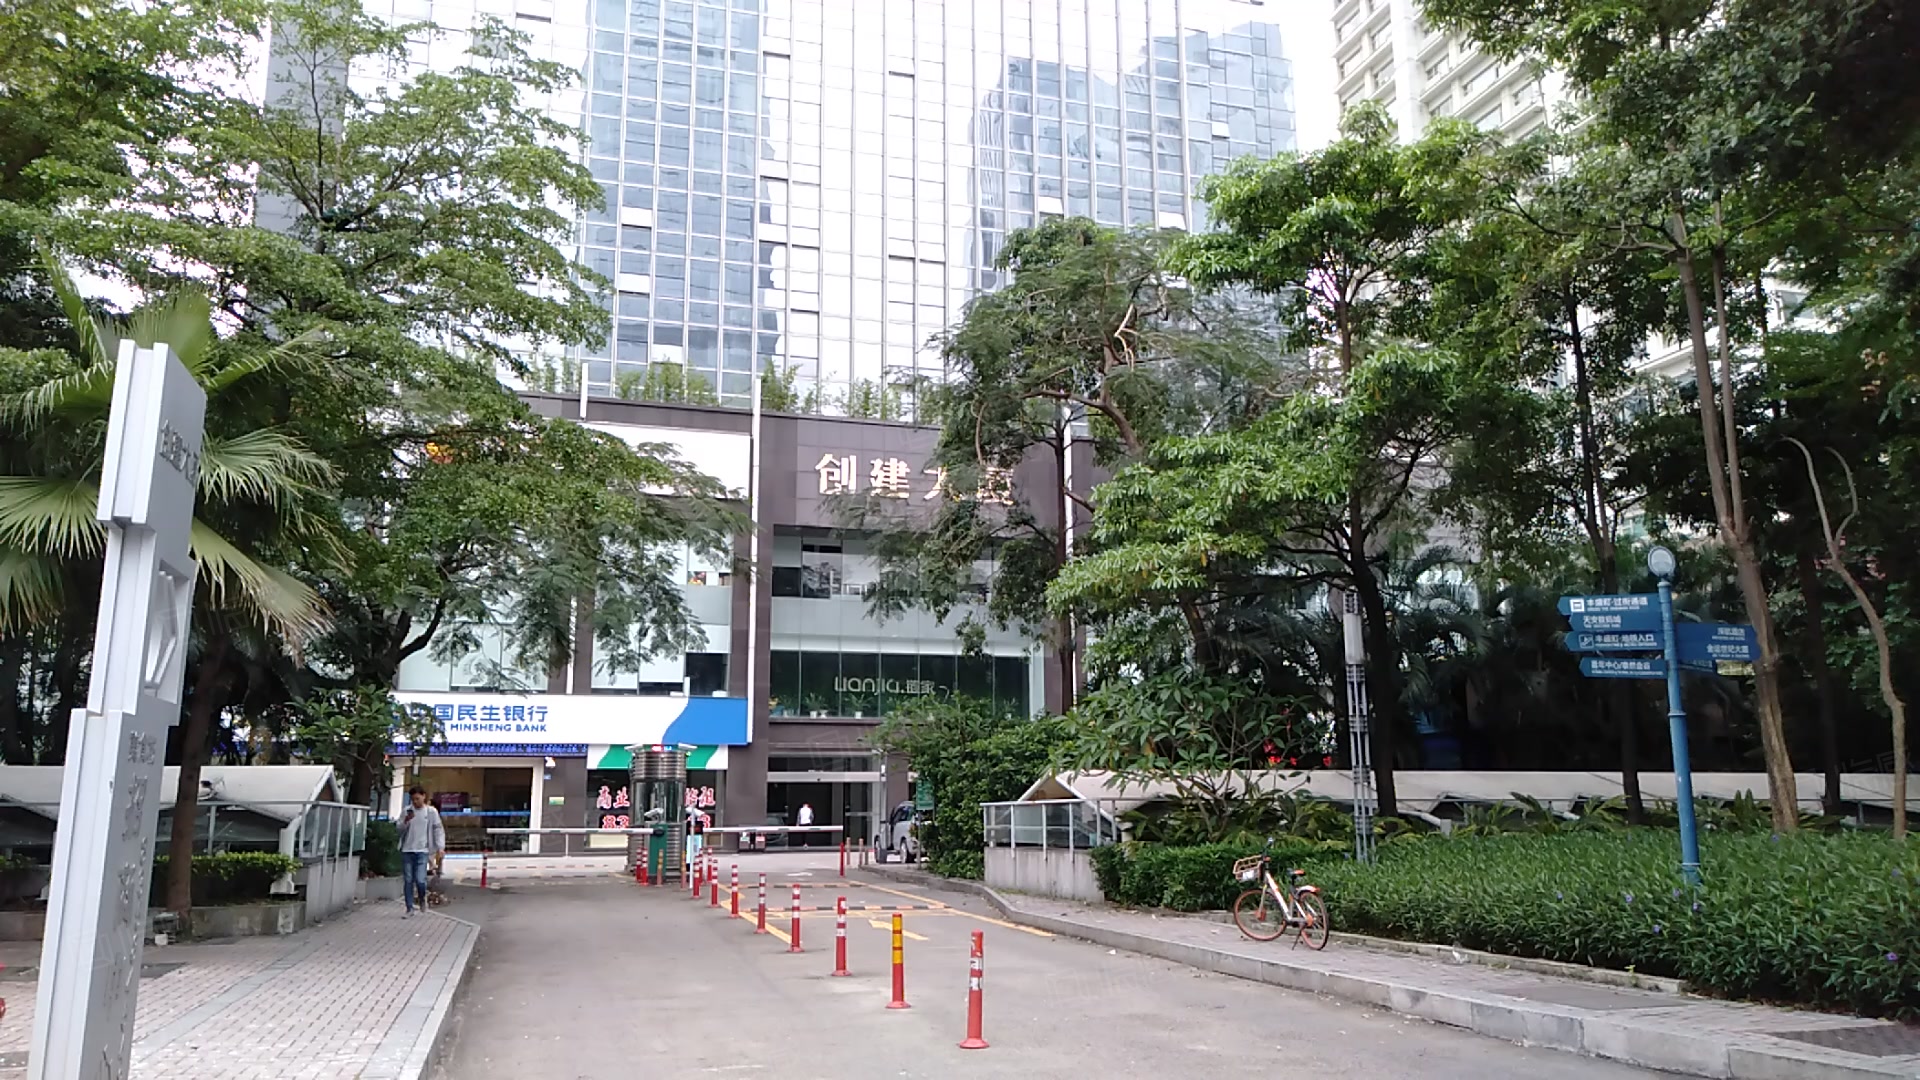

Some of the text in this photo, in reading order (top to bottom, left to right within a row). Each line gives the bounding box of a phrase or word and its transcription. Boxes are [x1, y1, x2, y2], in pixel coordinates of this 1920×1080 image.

[412, 703, 548, 722] 国民生银行
[450, 723, 512, 732] MINSHENG
[515, 724, 547, 732] BANK
